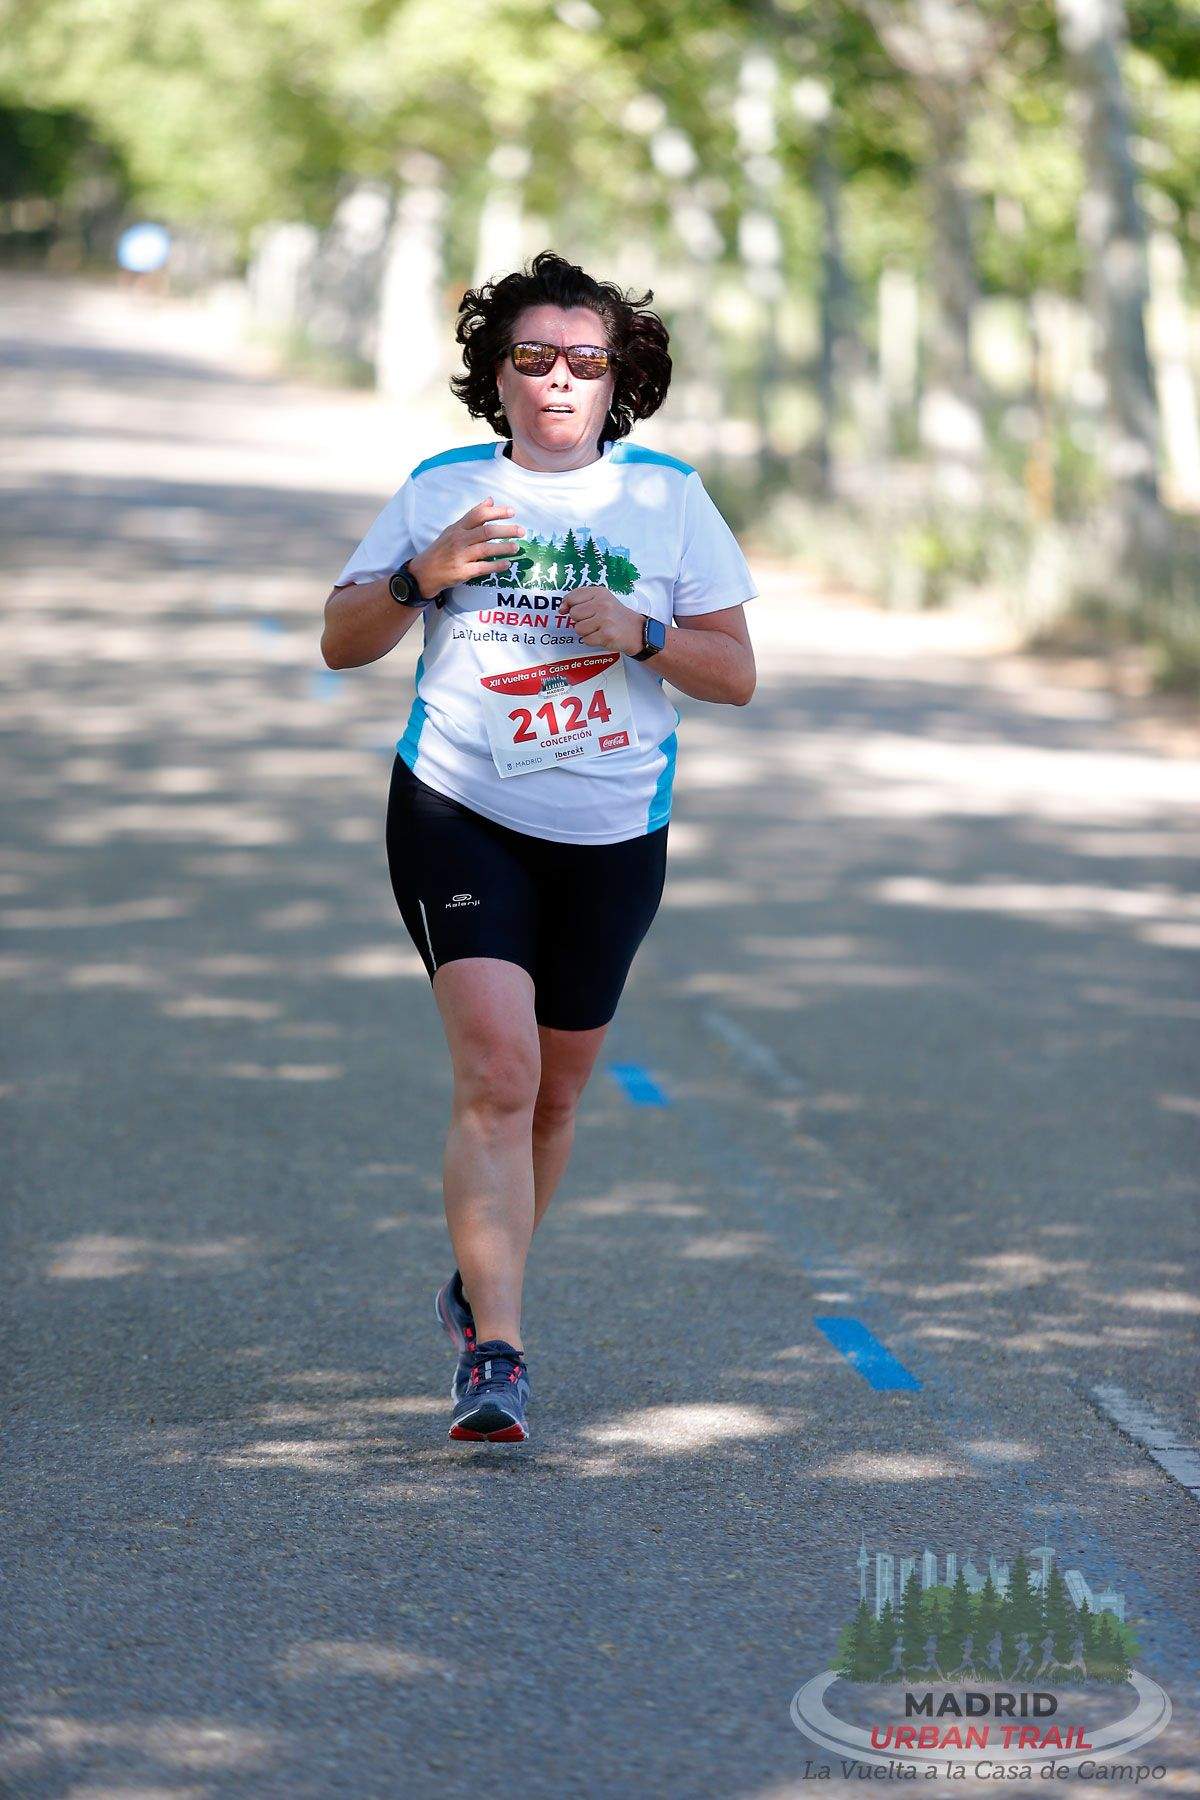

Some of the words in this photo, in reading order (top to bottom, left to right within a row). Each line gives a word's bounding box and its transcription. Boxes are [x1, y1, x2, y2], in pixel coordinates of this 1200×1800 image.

[497, 592, 563, 611] MADR
[478, 610, 549, 629] URBAN
[452, 628, 466, 640] La
[466, 629, 508, 642] Vuelta
[511, 633, 520, 643] a
[524, 632, 536, 645] la
[540, 633, 574, 646] Casa
[489, 679, 501, 688] XII
[502, 673, 530, 685] Vuelta
[539, 668, 547, 677] la
[549, 664, 570, 674] Casa
[571, 660, 582, 670] de
[584, 656, 614, 667] Campo
[507, 689, 612, 744] 2124
[540, 729, 593, 748] CONCEPCIÓN
[554, 746, 584, 759] Iberext
[515, 757, 543, 768] MADRID
